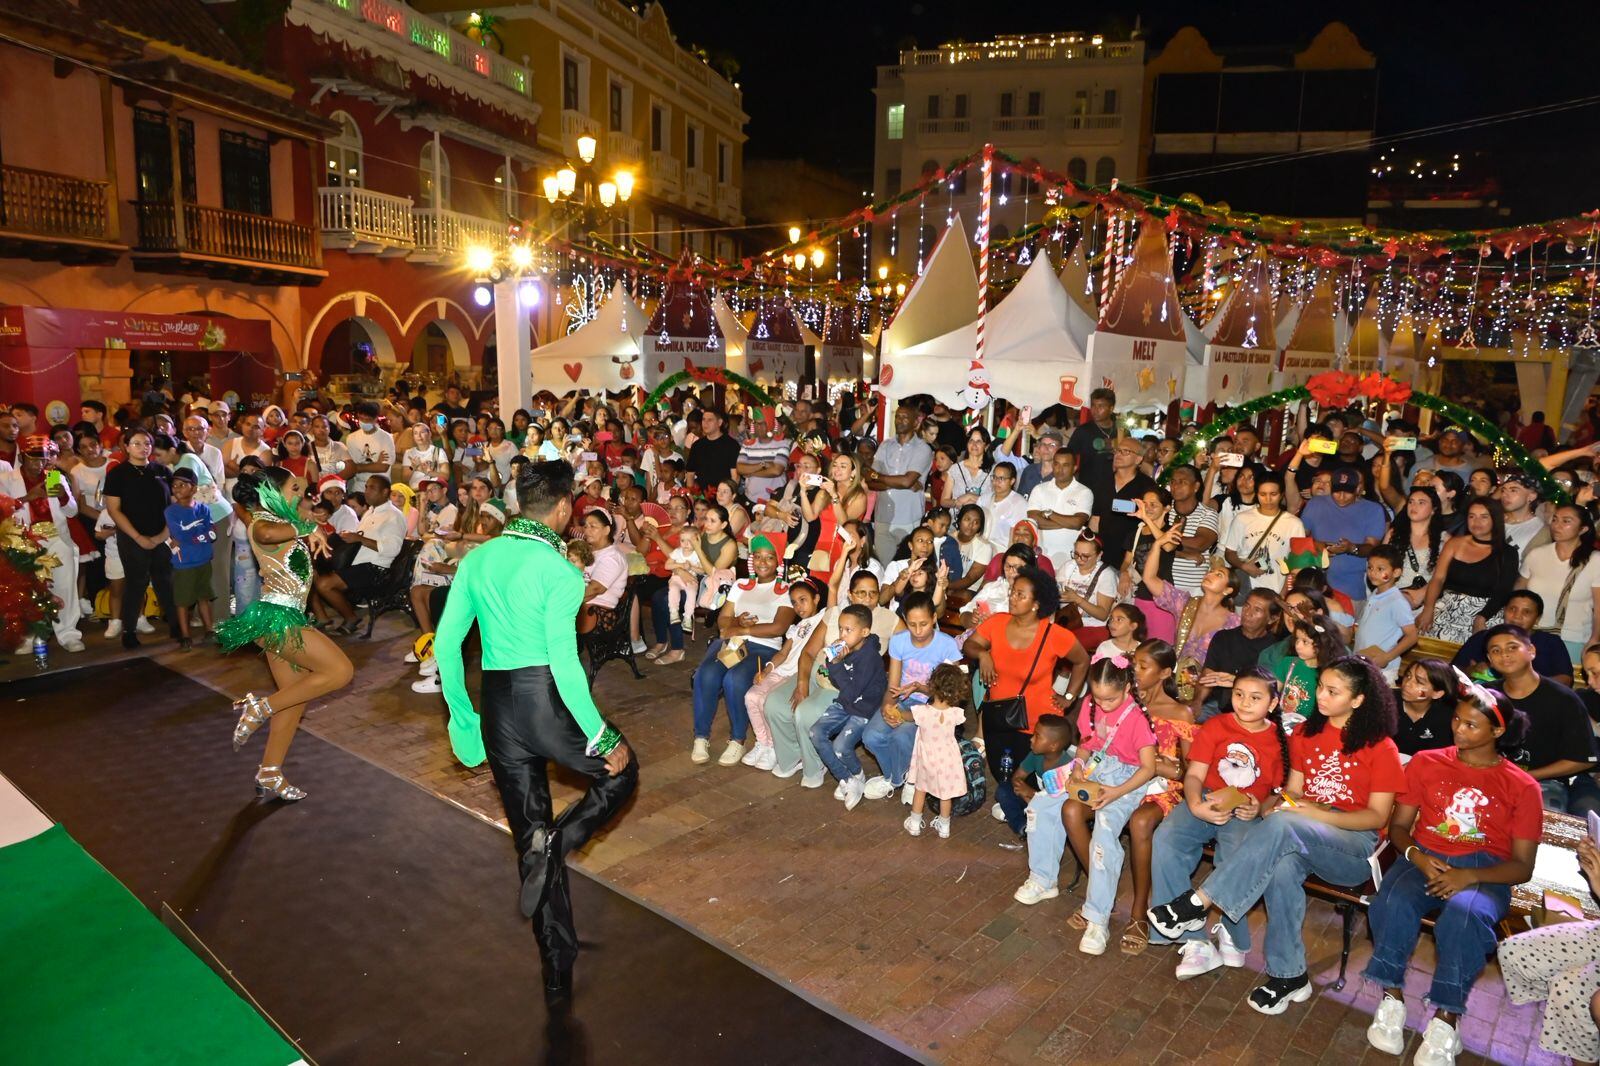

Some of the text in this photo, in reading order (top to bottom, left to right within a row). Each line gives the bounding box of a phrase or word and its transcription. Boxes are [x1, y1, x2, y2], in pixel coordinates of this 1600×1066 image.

[1132, 340, 1157, 361] MELT
[1214, 351, 1221, 362] LA
[1315, 777, 1342, 793] Merry
